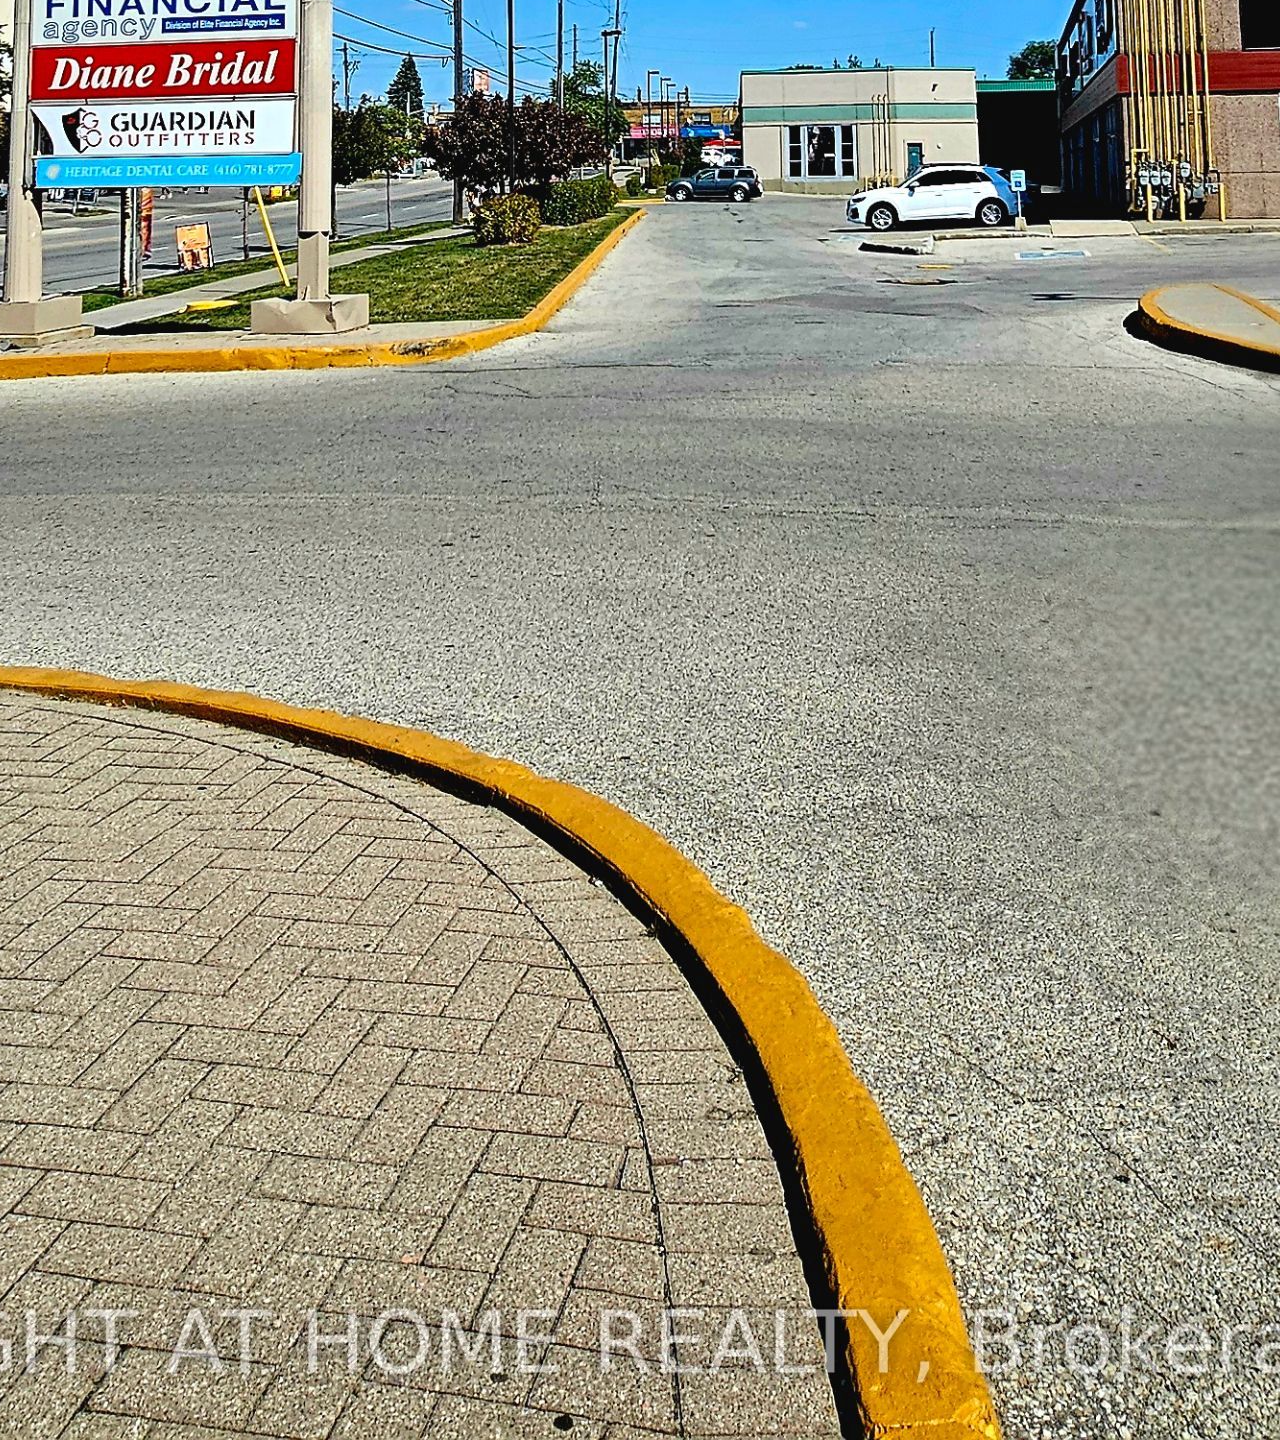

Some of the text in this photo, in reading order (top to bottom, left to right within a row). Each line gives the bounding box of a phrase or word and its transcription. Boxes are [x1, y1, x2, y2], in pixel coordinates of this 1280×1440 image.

[43, 17, 157, 43] agency
[192, 20, 199, 29] of
[215, 18, 244, 28] Financial
[244, 18, 268, 29] Agency
[269, 17, 282, 27] Inc.
[47, 49, 279, 91] Diane Bridal
[110, 109, 256, 132] GUARDIAN
[109, 131, 255, 148] OUTFITTERS
[65, 163, 294, 177] HERITAGE DENTAL CARE (416) 781-8777
